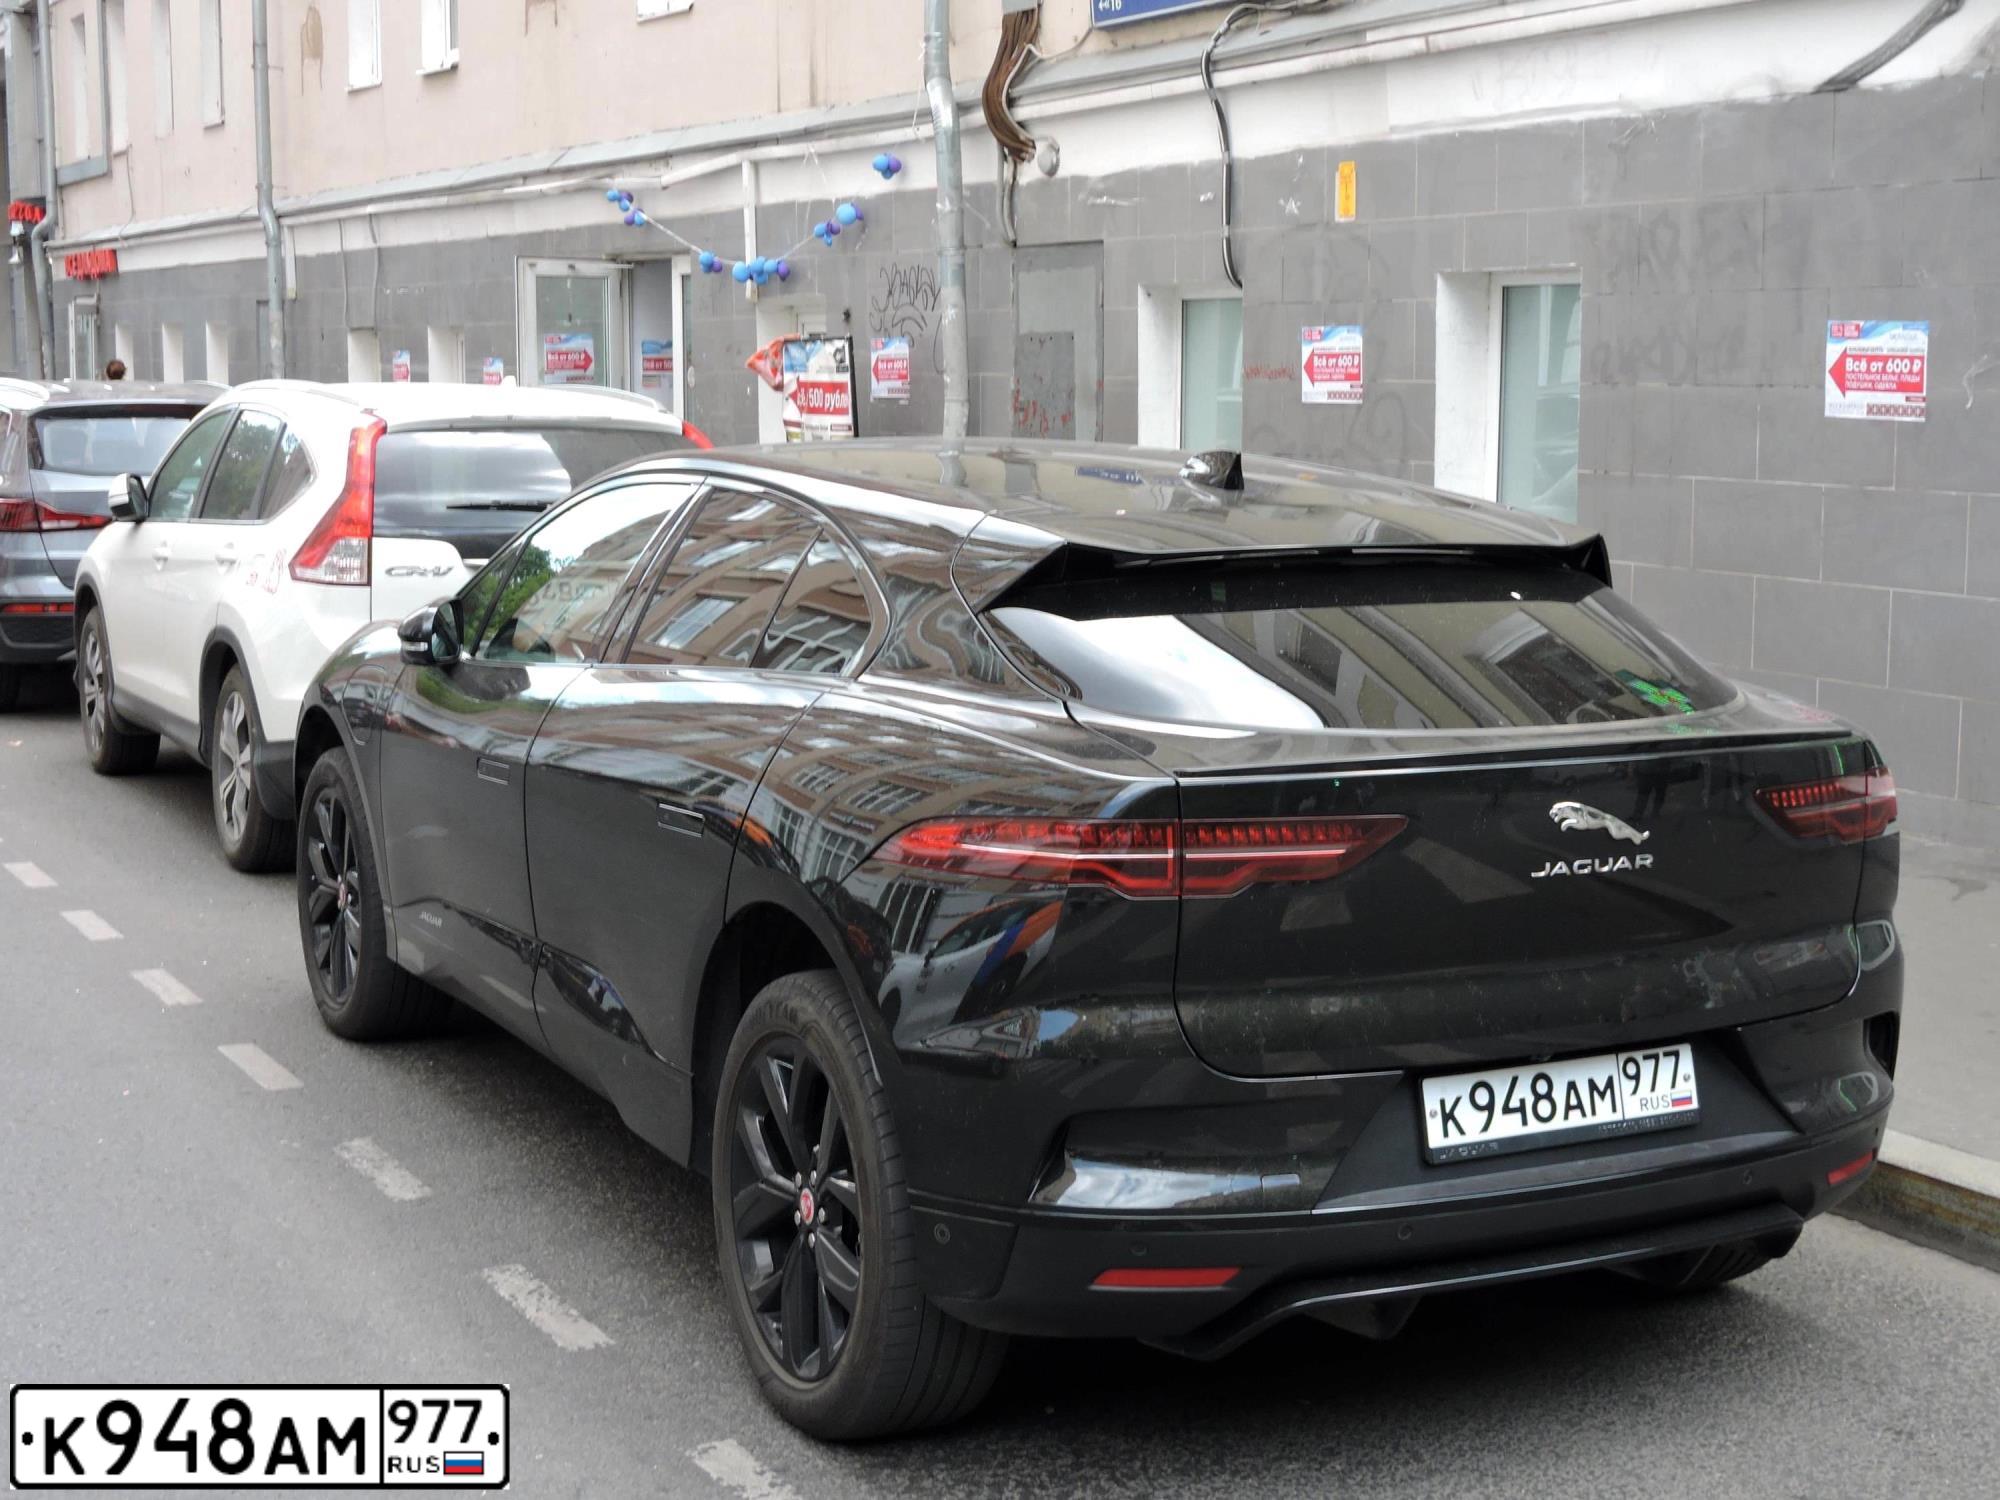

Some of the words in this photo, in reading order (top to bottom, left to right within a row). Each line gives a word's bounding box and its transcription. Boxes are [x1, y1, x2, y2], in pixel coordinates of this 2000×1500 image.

[1328, 358, 1338, 368] от
[1338, 355, 1352, 368] 600
[1869, 361, 1883, 373] от
[1886, 358, 1911, 374] 600
[1530, 853, 1654, 878] JAGUAR
[1621, 1049, 1681, 1096] 977
[1639, 1095, 1671, 1113] RUS
